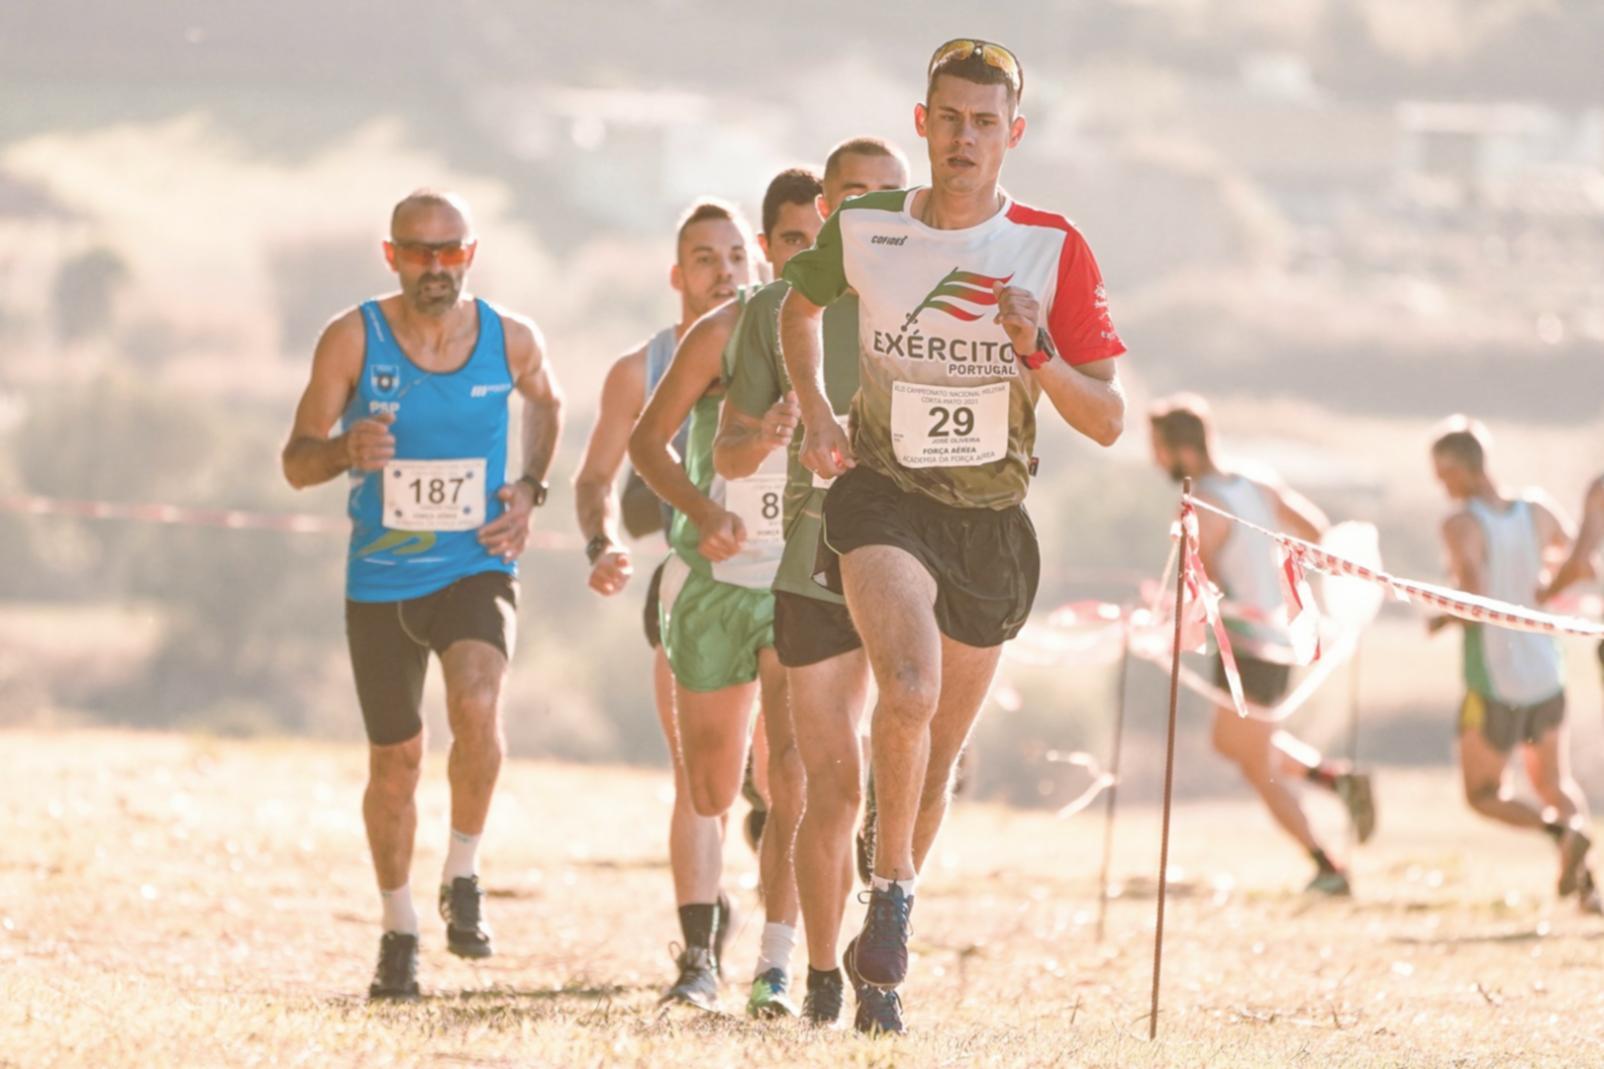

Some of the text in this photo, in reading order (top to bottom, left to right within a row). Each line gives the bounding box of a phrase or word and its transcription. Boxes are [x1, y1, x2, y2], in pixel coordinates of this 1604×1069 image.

[873, 329, 1014, 363] EXÉRCITO
[949, 364, 1016, 375] PORTUGAL
[928, 407, 975, 437] 29
[903, 455, 937, 464] ACADEMIA
[951, 455, 974, 463] FORÇA
[922, 445, 977, 455] FORÇA AÉREA
[409, 477, 465, 504] 187
